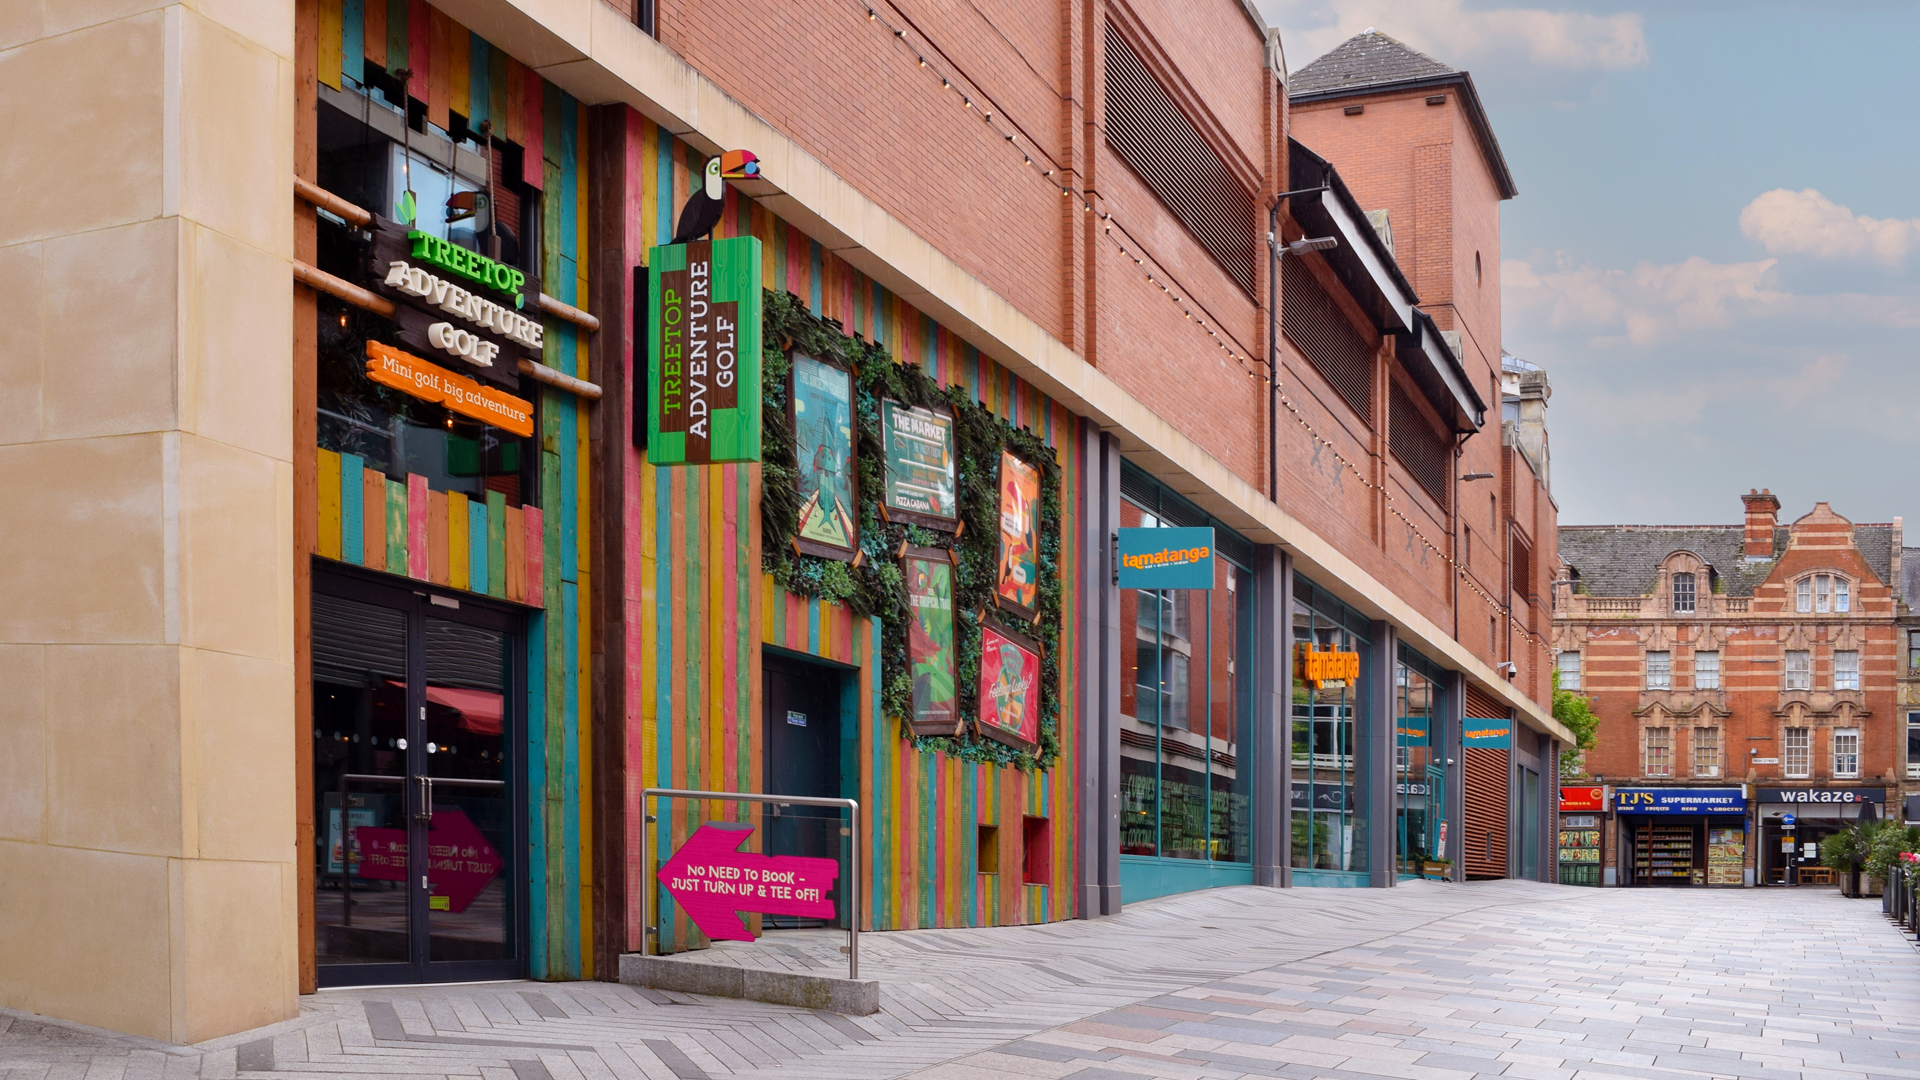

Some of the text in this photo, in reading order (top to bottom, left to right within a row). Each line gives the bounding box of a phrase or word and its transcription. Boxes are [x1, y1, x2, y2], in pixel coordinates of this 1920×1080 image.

[408, 230, 525, 294] TREETOP
[385, 260, 543, 348] ADVENTURE
[428, 322, 500, 367] GOLF
[664, 288, 682, 414] TREETOP
[690, 261, 708, 438] ADVENTURE
[716, 316, 734, 388] GOLF
[382, 355, 526, 422] Mini golf, big adventure
[892, 413, 910, 431] THE
[910, 418, 946, 442] MARKET
[1122, 546, 1210, 570] tamatanga
[909, 594, 919, 606] THE
[1464, 728, 1509, 739] tamatanga
[1617, 792, 1654, 804] TJ'S
[1780, 789, 1854, 803] wakaze
[687, 864, 705, 876] NO
[709, 865, 740, 880] NEED
[744, 868, 758, 881] TO
[762, 870, 795, 884] BOOK
[672, 877, 819, 903] JUST TURN UP & TEE OFF!
